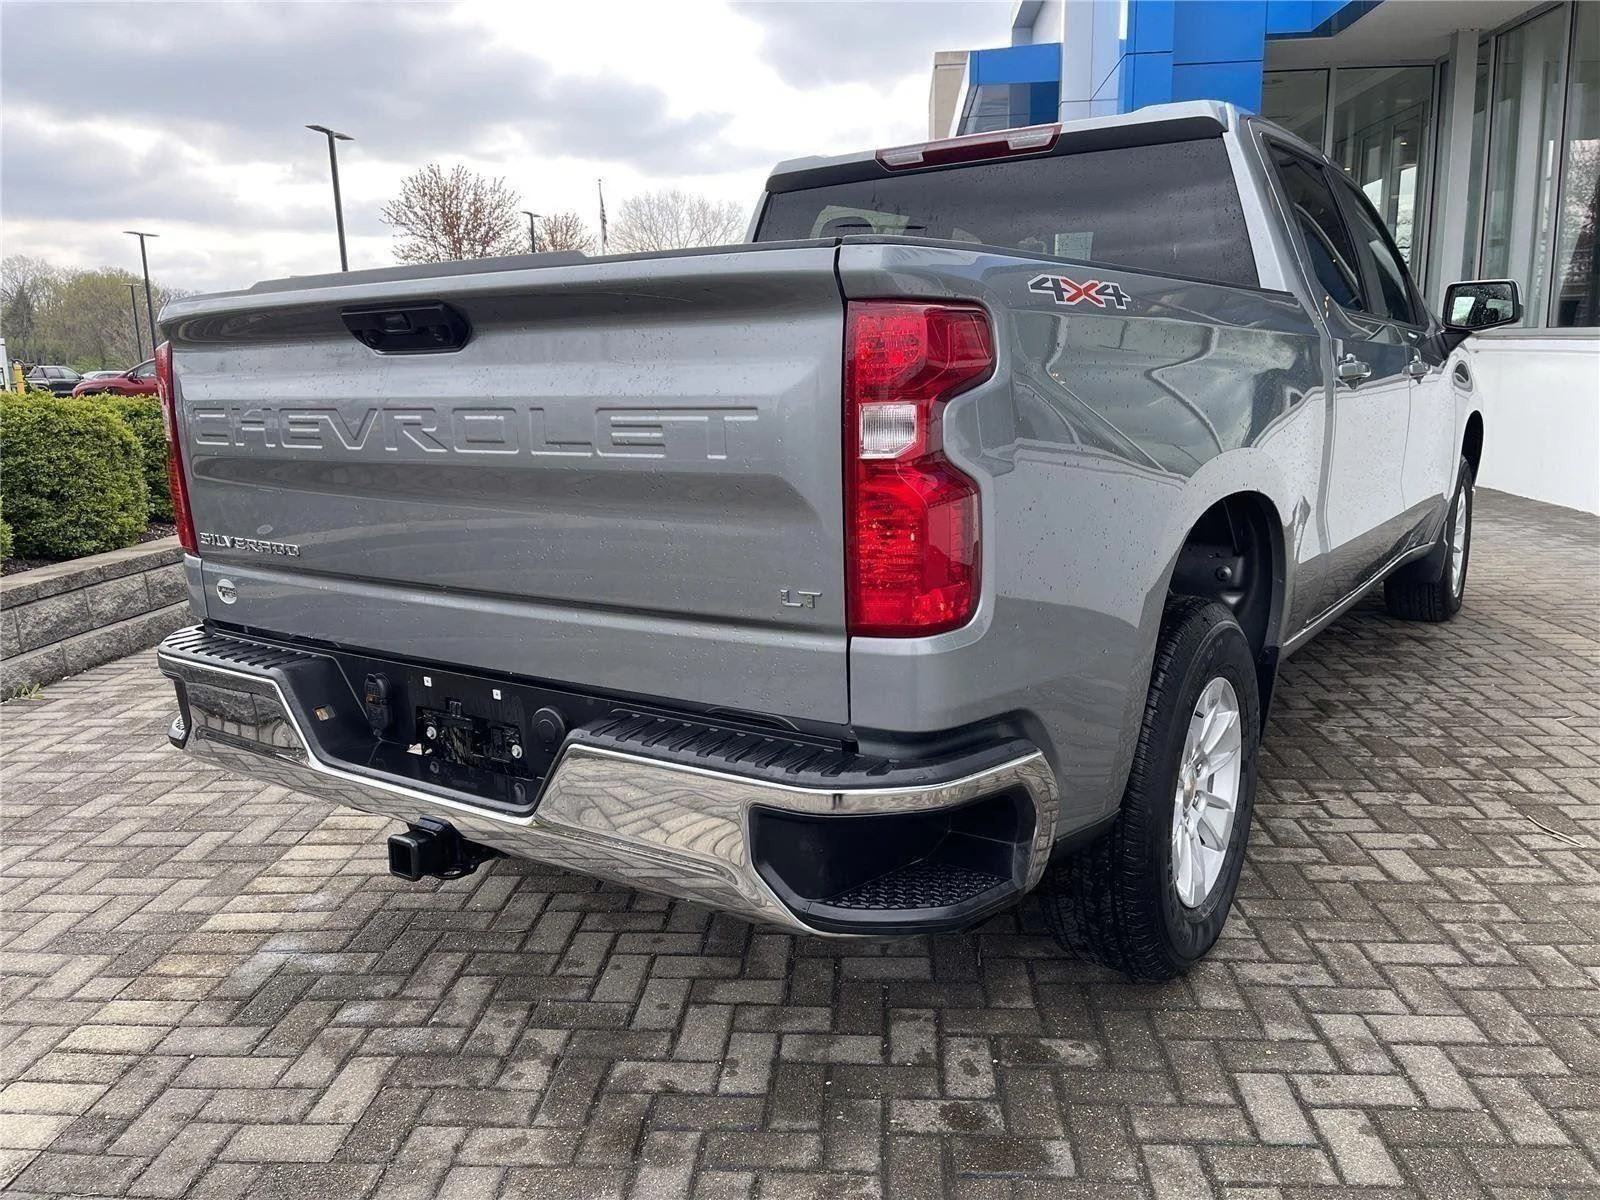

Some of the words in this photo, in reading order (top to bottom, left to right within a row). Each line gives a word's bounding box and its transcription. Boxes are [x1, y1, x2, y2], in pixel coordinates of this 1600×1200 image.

[192, 407, 759, 460] CHEVROLET
[199, 532, 301, 556] SILVERADO
[780, 589, 822, 609] LT
